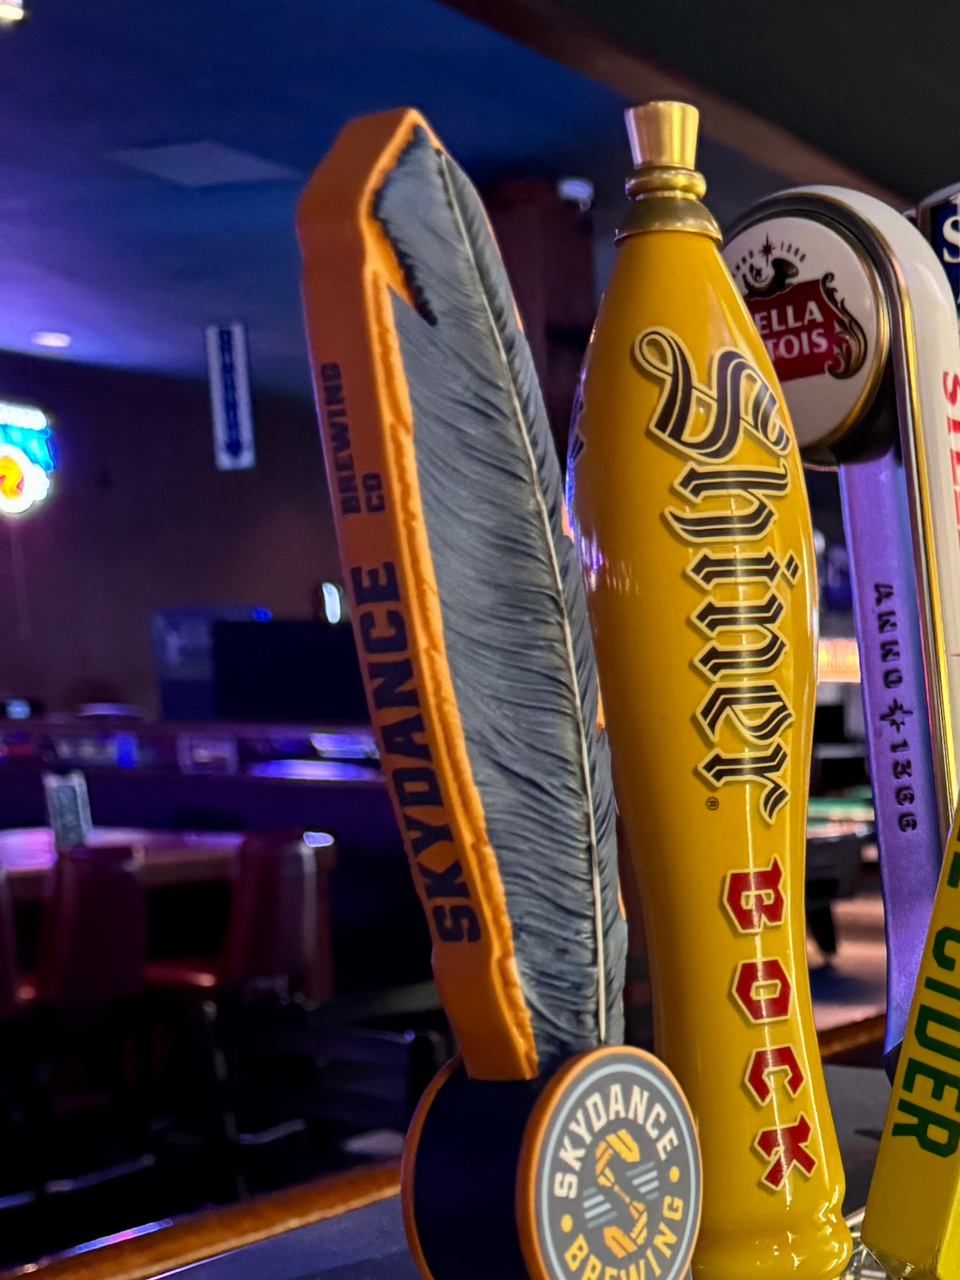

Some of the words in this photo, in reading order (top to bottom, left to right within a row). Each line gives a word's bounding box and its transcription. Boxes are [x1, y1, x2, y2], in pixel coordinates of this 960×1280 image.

[754, 300, 825, 335] ELLA
[764, 328, 829, 362] TOIS
[320, 362, 361, 515] BREWING
[362, 473, 386, 513] CO
[634, 326, 802, 824] Shiner
[351, 561, 482, 944] SKYDANCE
[723, 853, 818, 1192] BOCK
[554, 1083, 679, 1200] SKYDANCE
